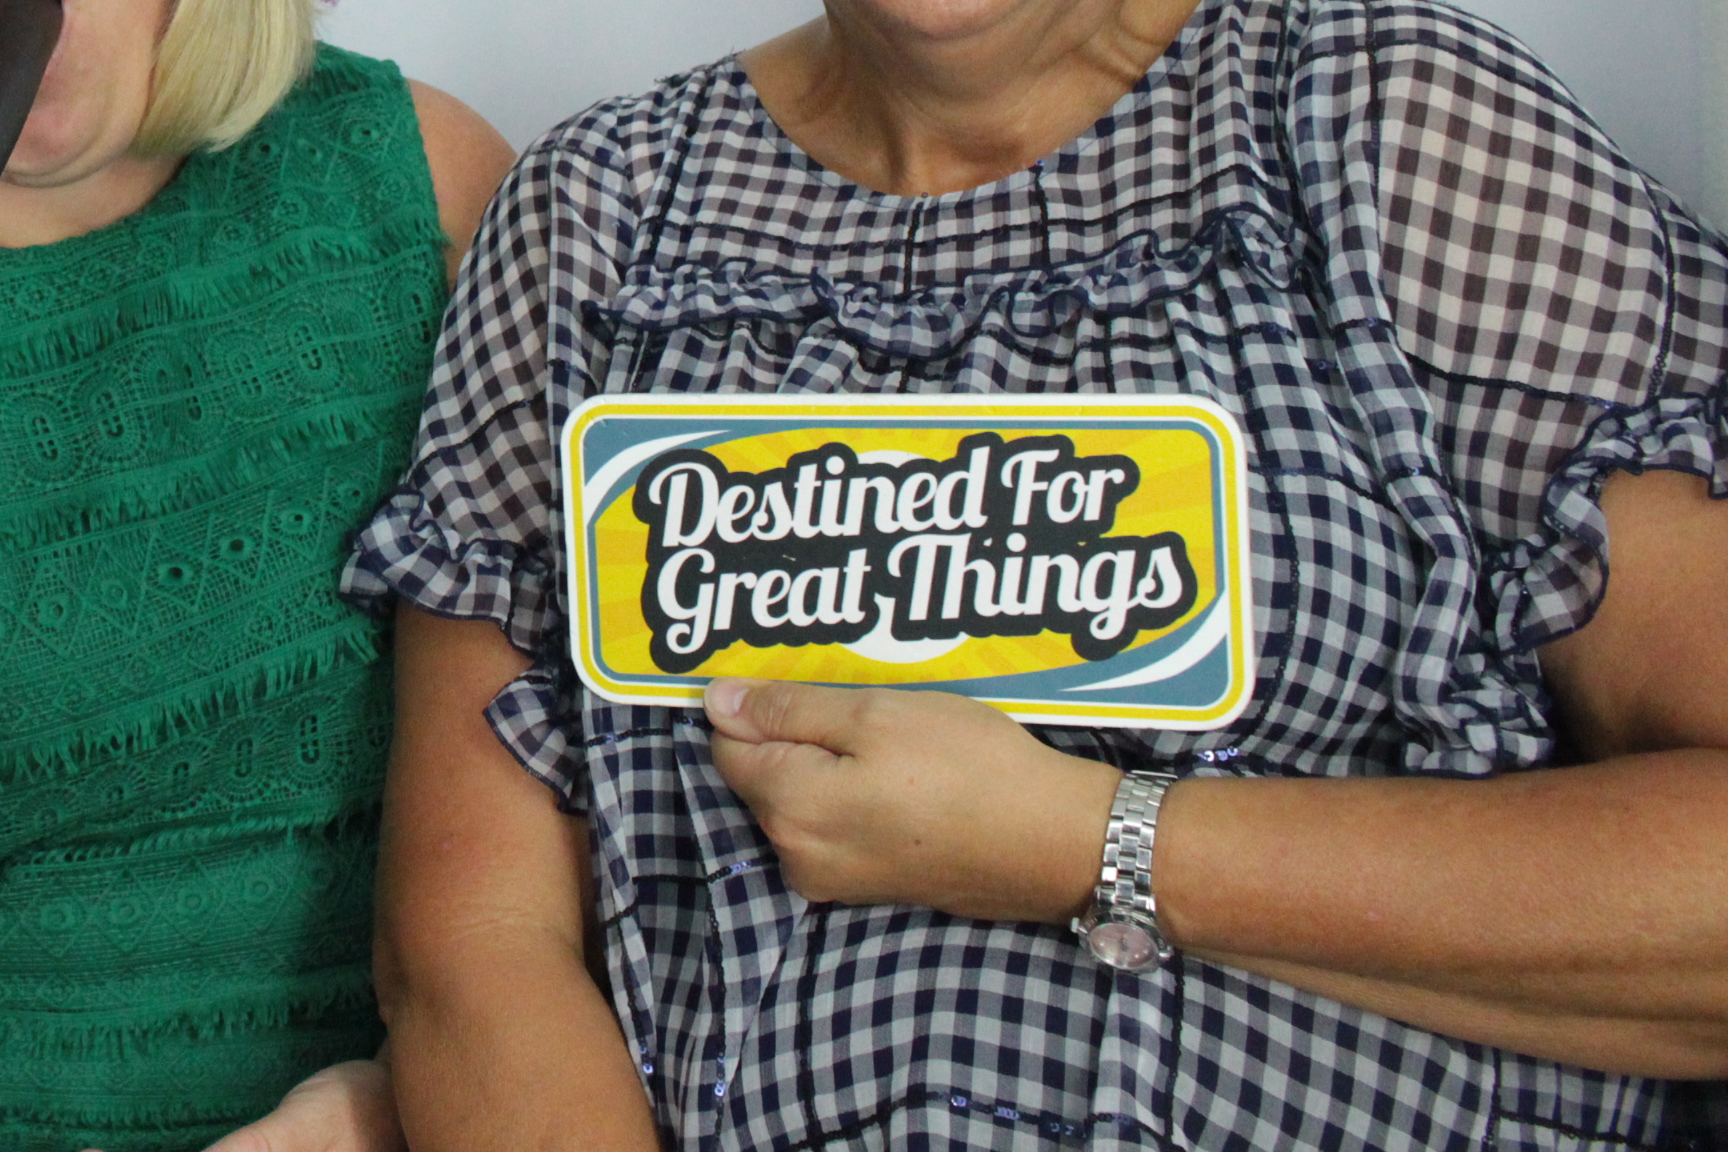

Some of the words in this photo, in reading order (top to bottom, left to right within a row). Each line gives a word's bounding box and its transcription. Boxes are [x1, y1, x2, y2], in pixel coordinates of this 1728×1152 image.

[650, 446, 990, 547] Destined
[1001, 448, 1125, 525] For
[657, 548, 871, 655] Great
[886, 532, 1184, 640] Things
